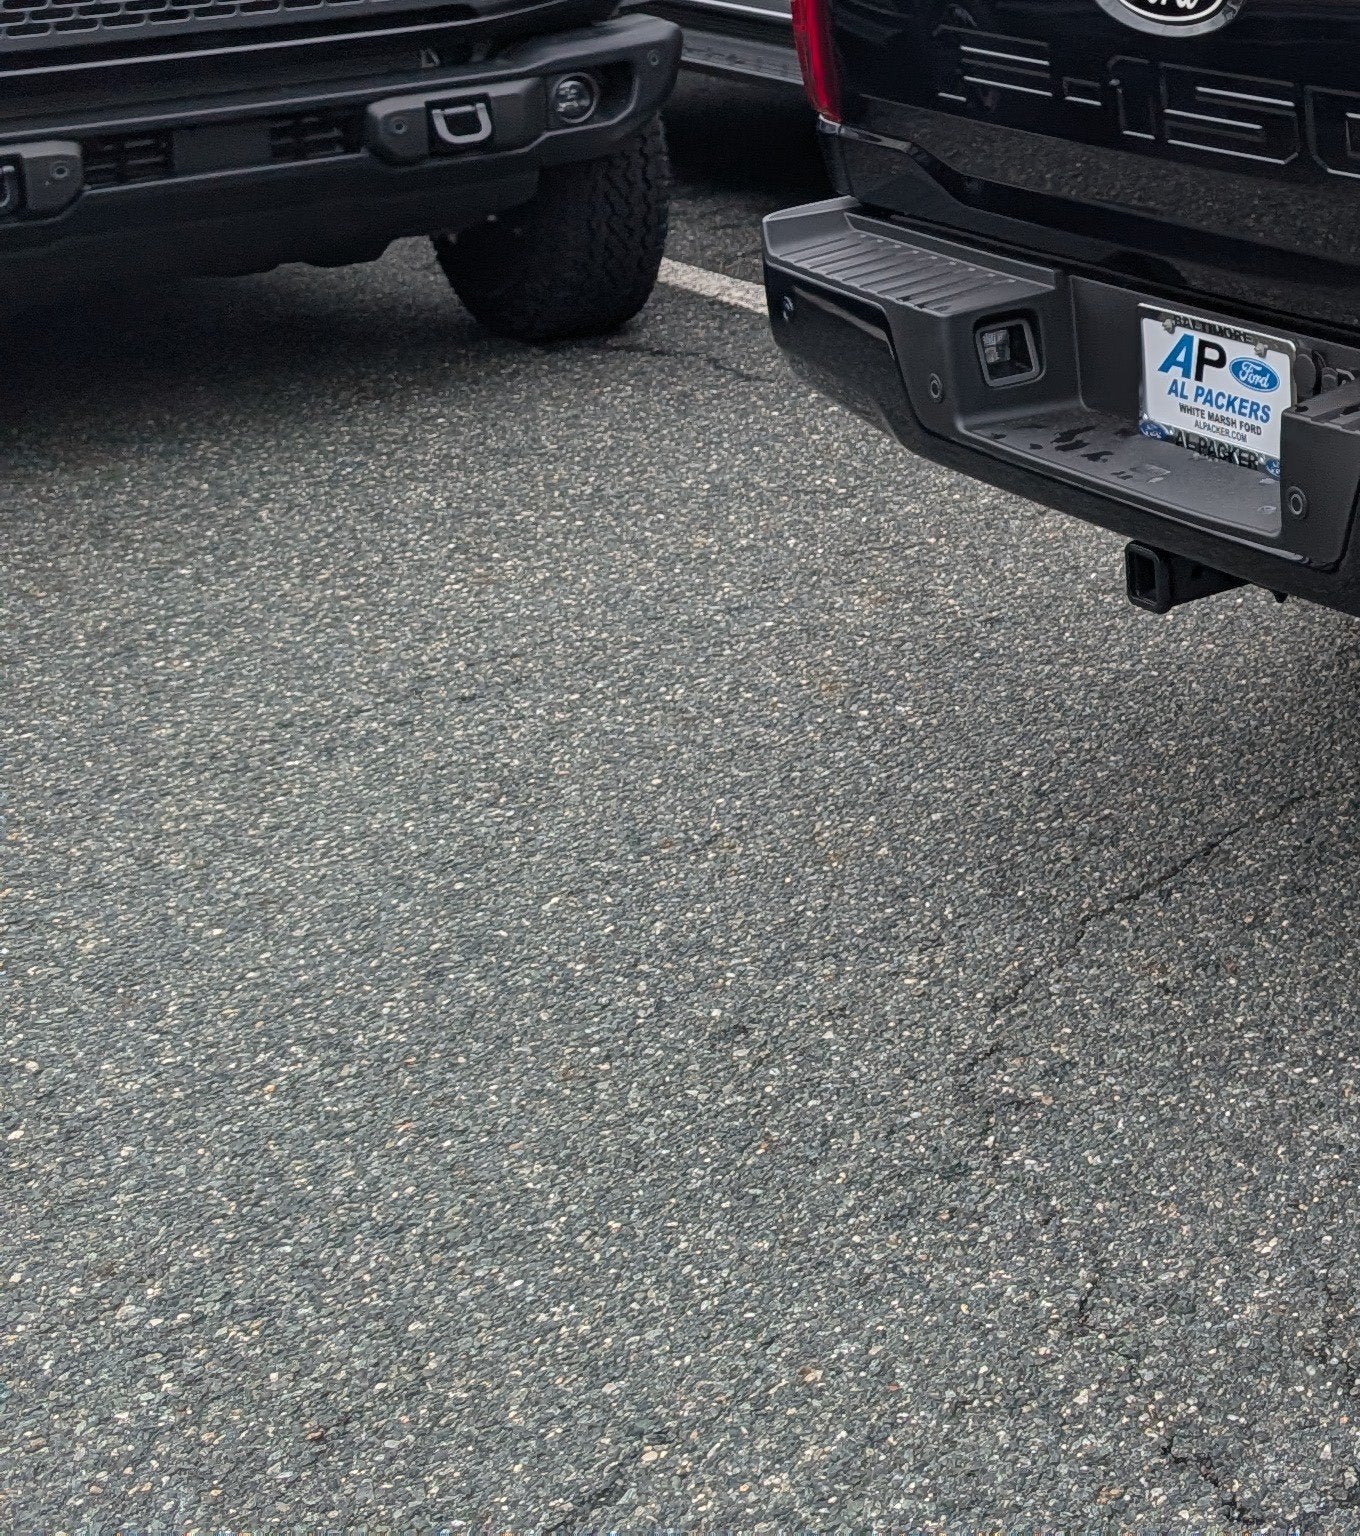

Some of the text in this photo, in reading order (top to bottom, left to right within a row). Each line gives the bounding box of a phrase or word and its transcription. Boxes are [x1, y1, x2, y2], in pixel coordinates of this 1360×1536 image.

[1172, 314, 1255, 344] BALTIMORE
[1158, 333, 1227, 383] AP
[1237, 361, 1270, 389] Ford
[1167, 378, 1272, 424] AL PACKERS
[1178, 402, 1262, 437] WHITE MARSH FORD
[1194, 419, 1248, 444] ALPACKER.COM
